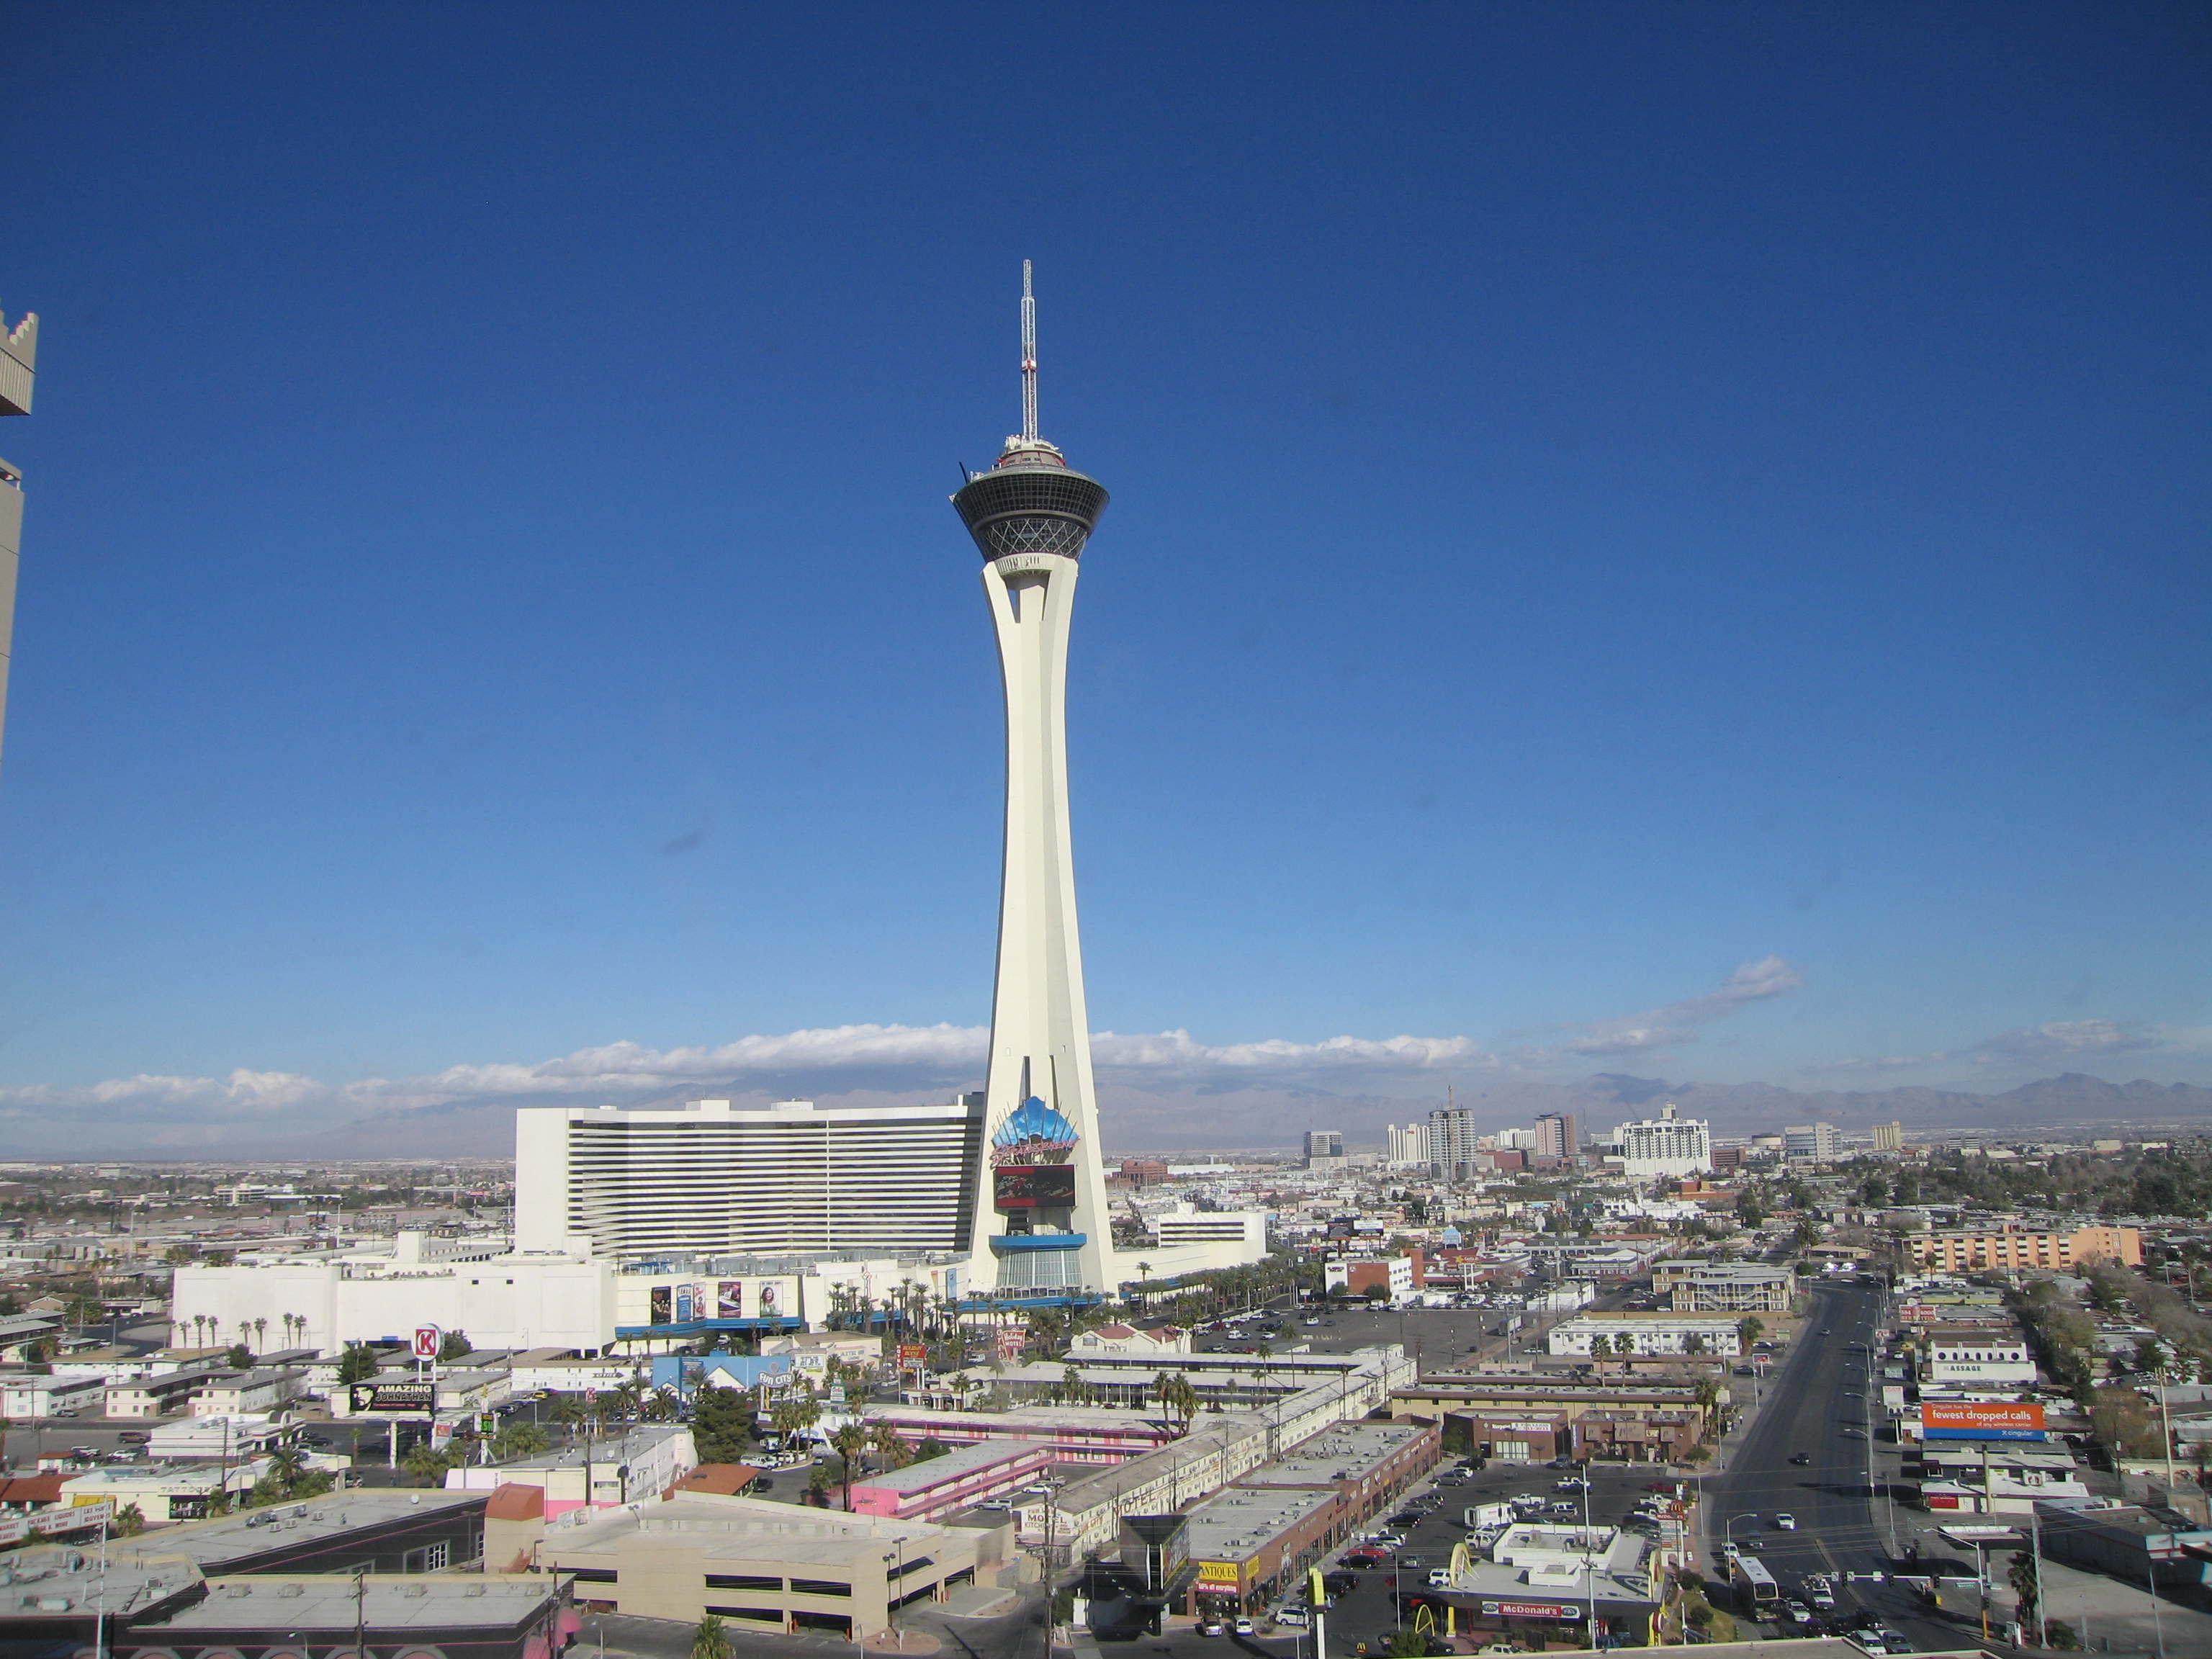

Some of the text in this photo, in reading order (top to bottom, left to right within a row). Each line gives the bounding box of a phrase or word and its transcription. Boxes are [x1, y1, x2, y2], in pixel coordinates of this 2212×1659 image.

[1004, 1332, 1022, 1342] Holiday
[421, 1333, 434, 1354] K
[759, 1372, 793, 1385] FUN CITY
[375, 1393, 432, 1401] JOHNATHAN
[1932, 1409, 2031, 1421] fewest dropped calls
[1200, 1566, 1237, 1578] ANTIQUES
[1503, 1605, 1557, 1615] McDonald's
